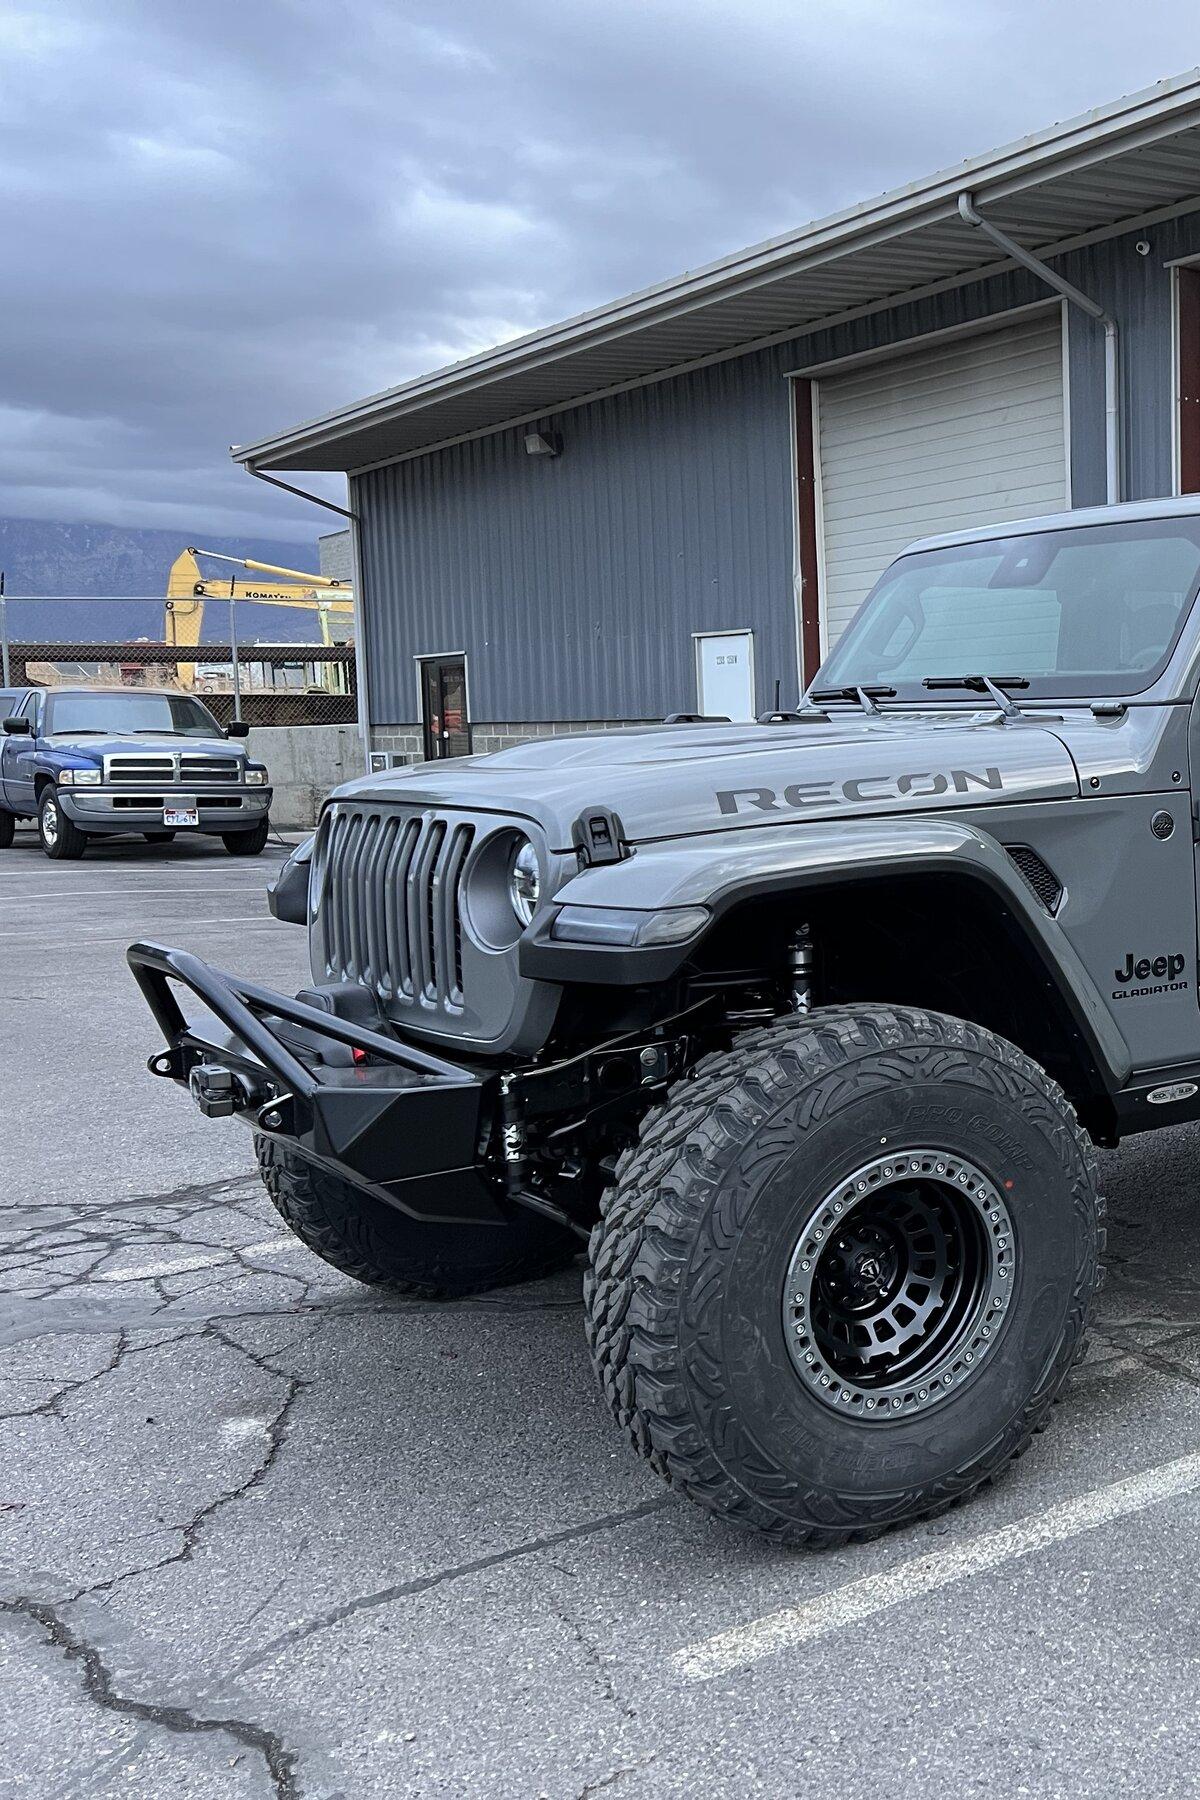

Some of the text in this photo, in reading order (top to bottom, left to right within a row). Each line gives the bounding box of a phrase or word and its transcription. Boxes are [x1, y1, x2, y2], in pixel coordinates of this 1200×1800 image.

[716, 767, 1003, 815] RECON
[1115, 953, 1185, 983] Jeep
[1112, 981, 1188, 1000] GLADIATOR
[502, 1123, 523, 1161] FOX
